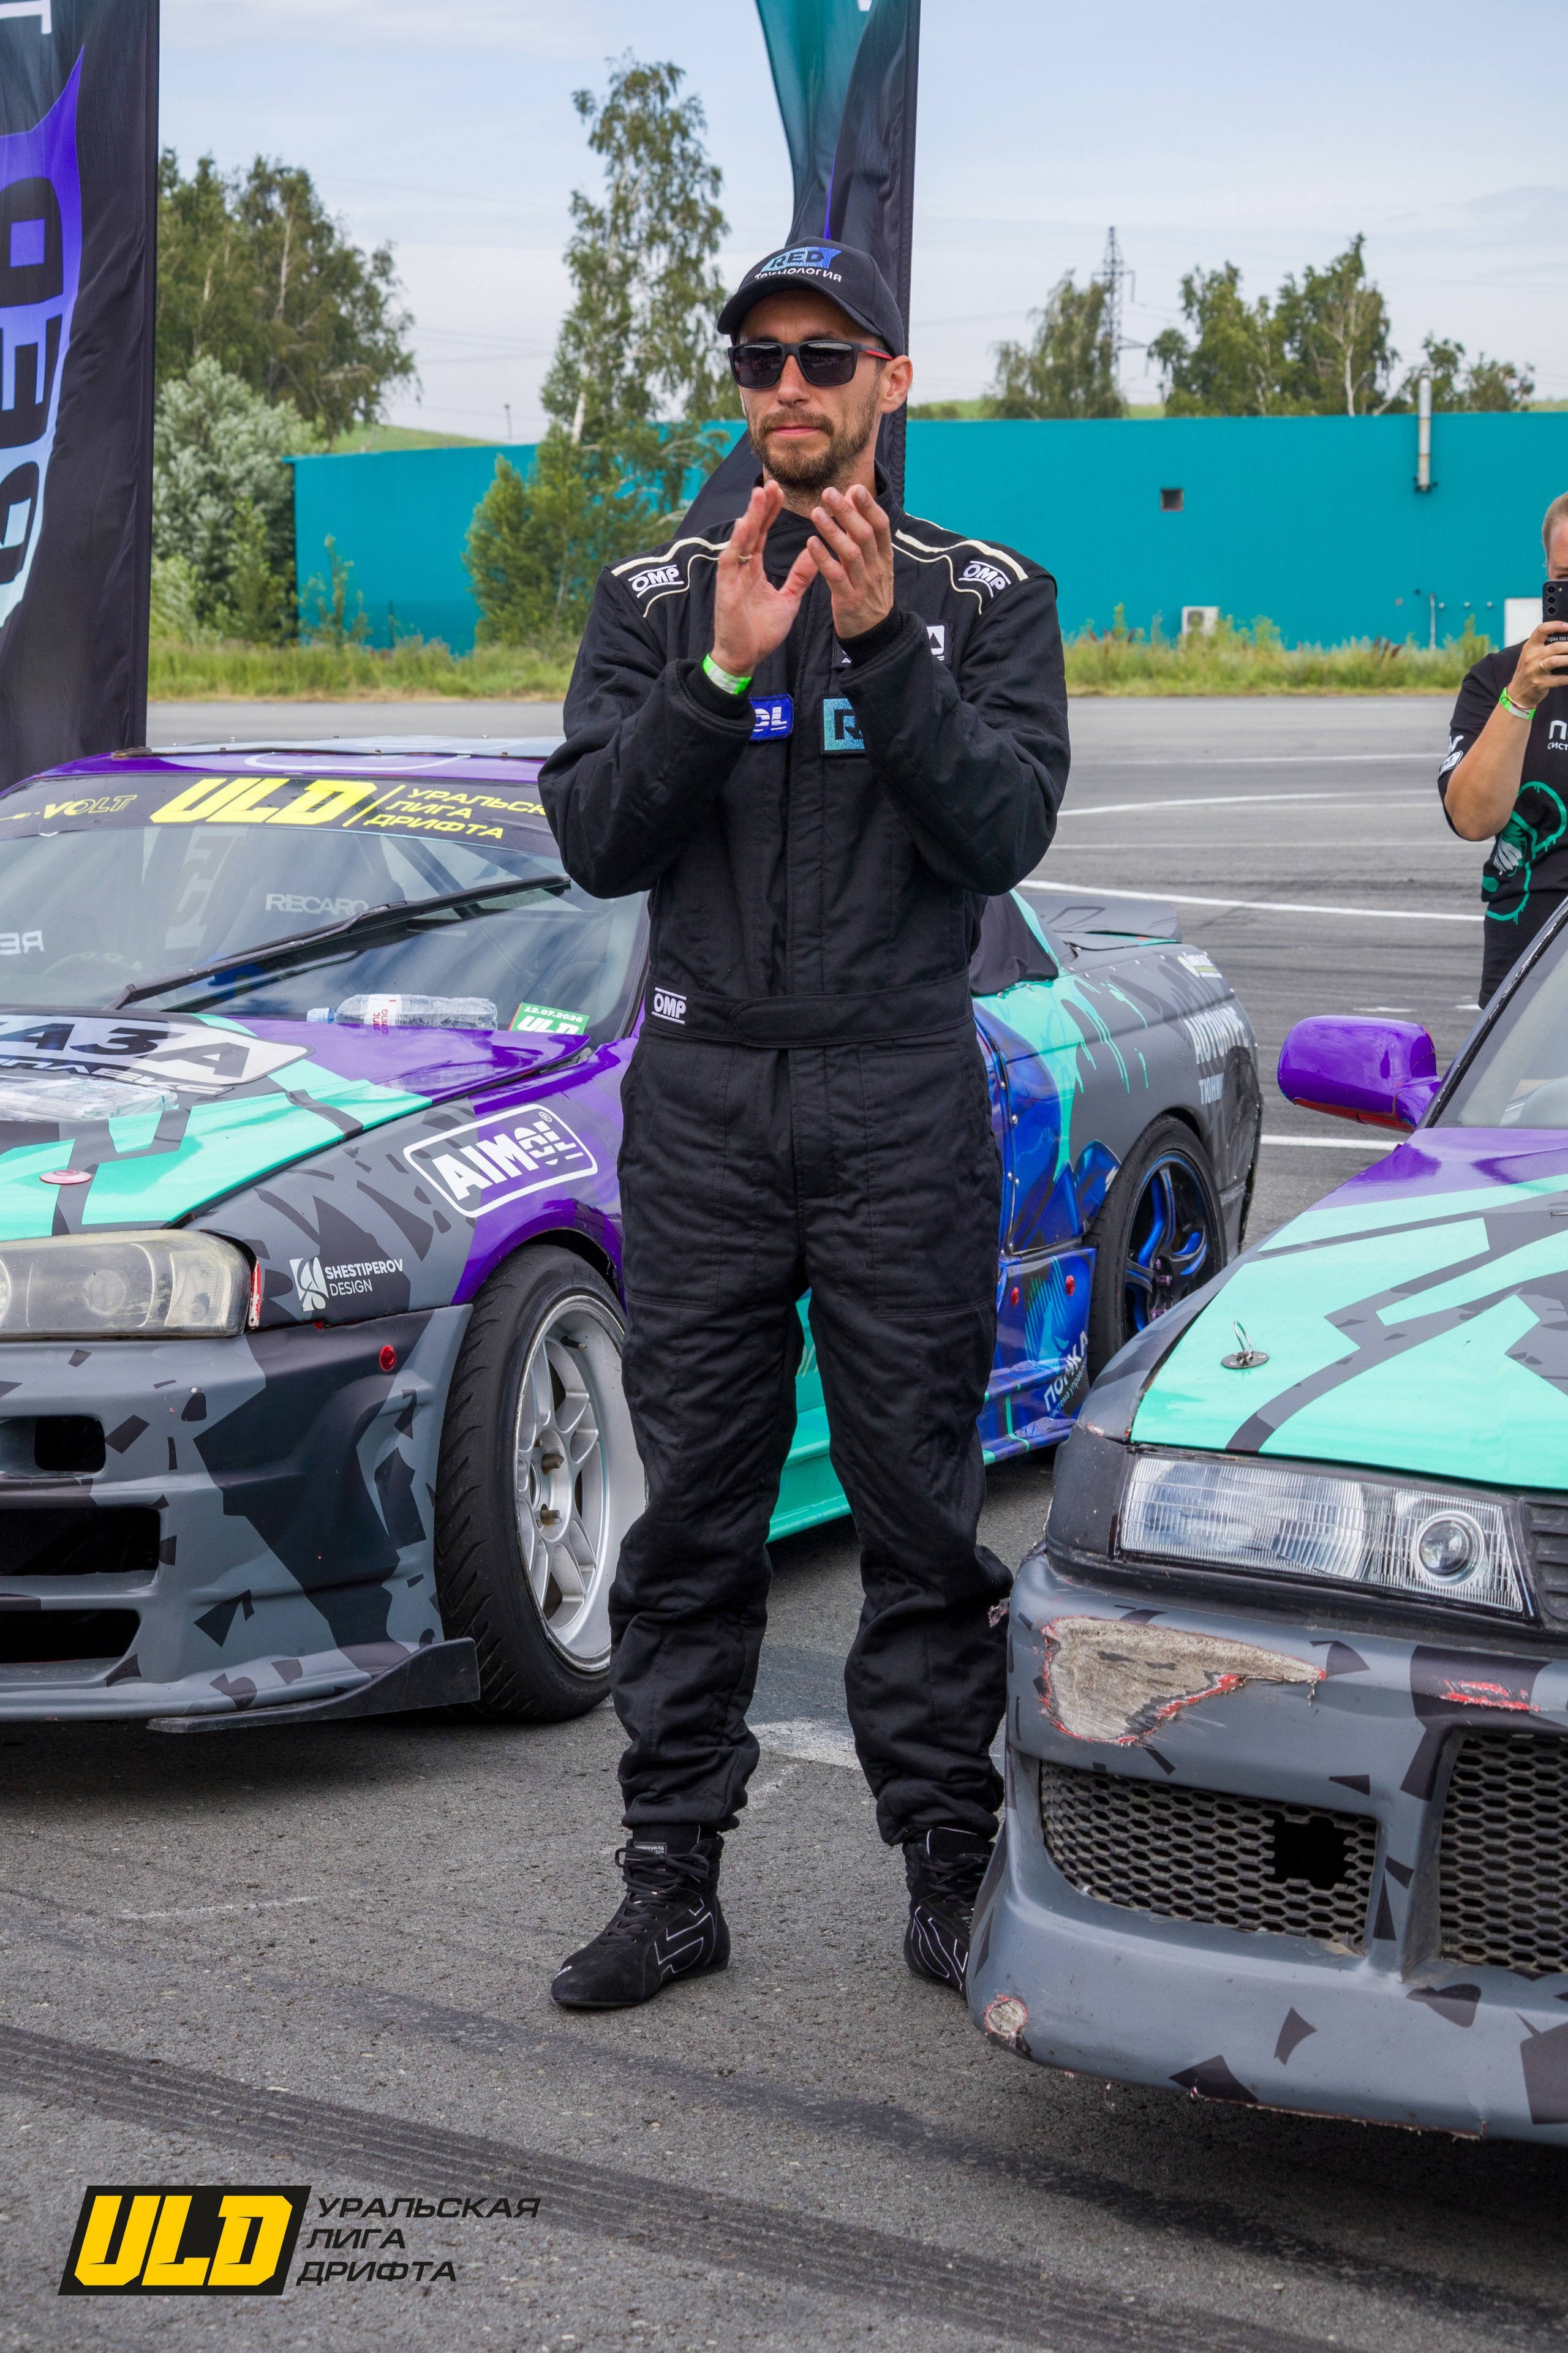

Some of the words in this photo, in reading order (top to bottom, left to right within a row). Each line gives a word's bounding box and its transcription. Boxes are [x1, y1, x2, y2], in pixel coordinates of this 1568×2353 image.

[771, 250, 824, 268] RED
[631, 567, 680, 592] OMP
[962, 563, 1007, 590] OMP
[43, 794, 138, 819] VOLT
[149, 778, 378, 826] ULD
[386, 800, 472, 819] ЛИГА
[407, 788, 546, 816] УРАЛЬСК
[364, 813, 503, 839] ДРИФТА
[265, 894, 369, 916] RECARO
[653, 992, 687, 1019] OMP
[516, 1015, 580, 1035] ULD
[1199, 1072, 1224, 1105] ТЮНИ
[324, 1259, 403, 1280] SHESTIPEROV
[329, 1279, 373, 1297] DESIGN
